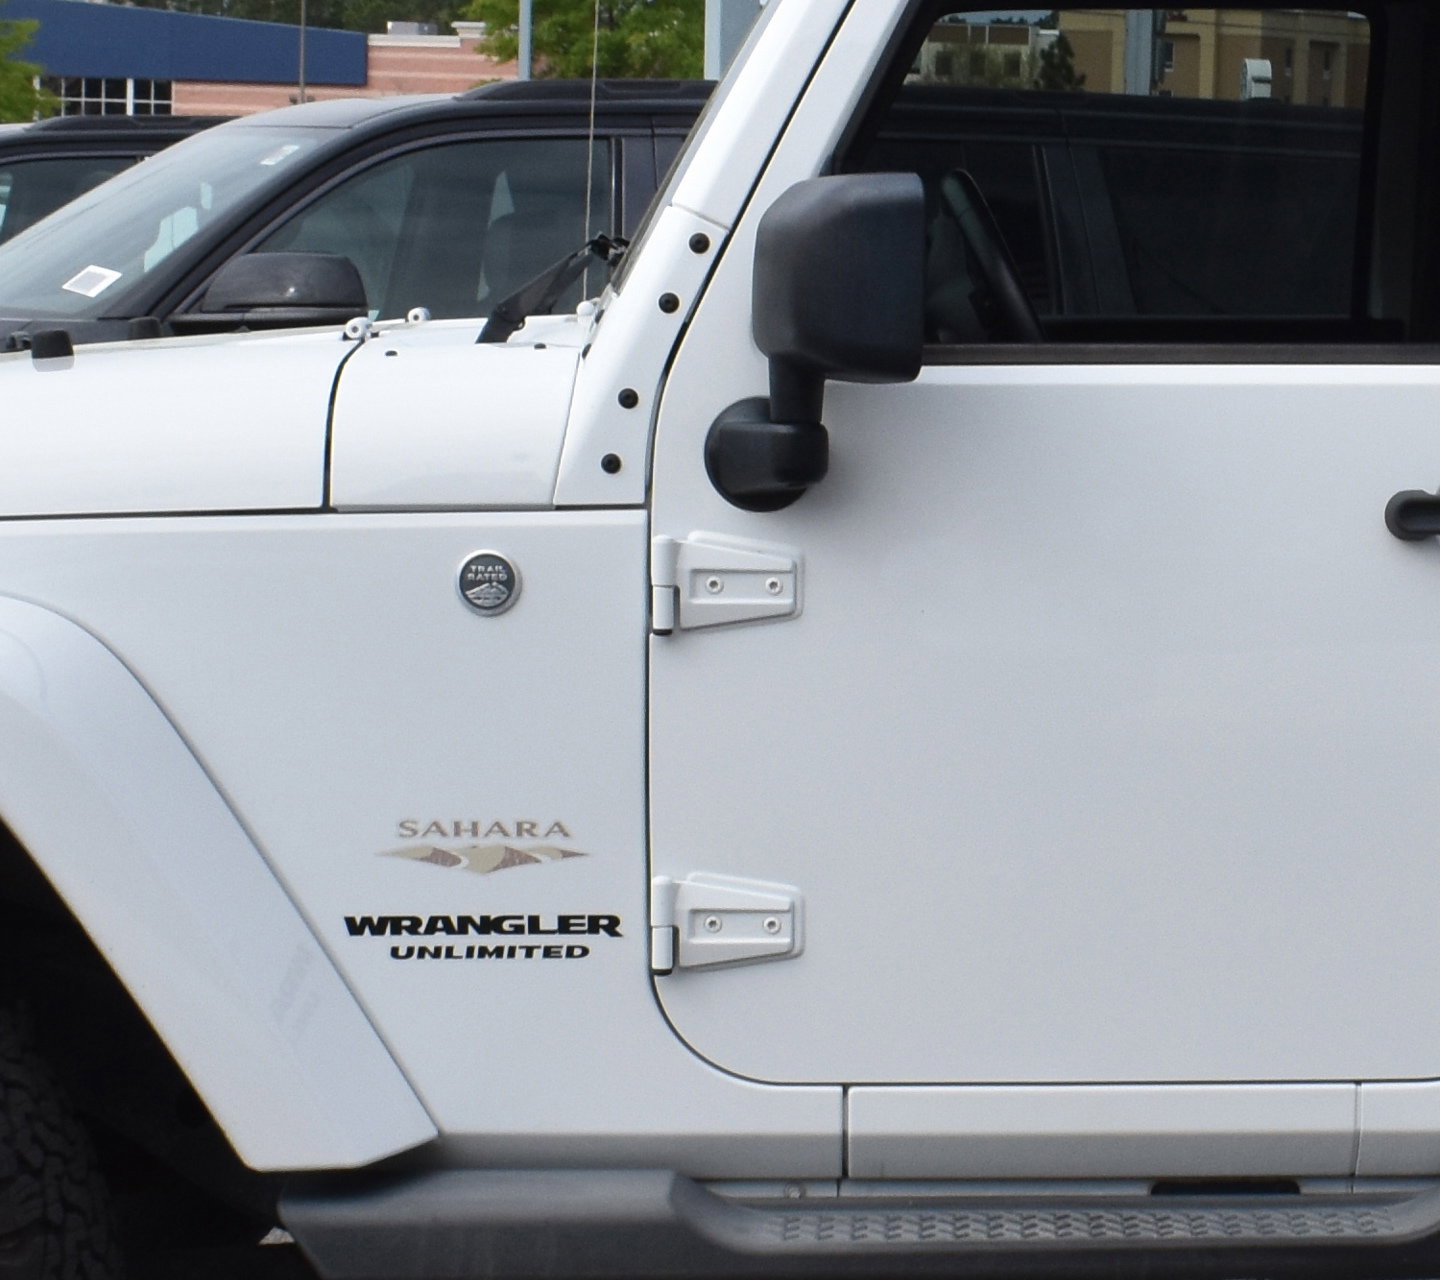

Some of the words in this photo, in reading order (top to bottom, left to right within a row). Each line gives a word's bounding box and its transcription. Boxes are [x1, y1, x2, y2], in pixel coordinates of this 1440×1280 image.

[467, 573, 508, 581] RATED
[469, 565, 506, 573] TRAIL
[398, 819, 571, 838] SAHARA
[343, 914, 624, 937] WRANGLER
[389, 944, 590, 960] UNLIMITED
